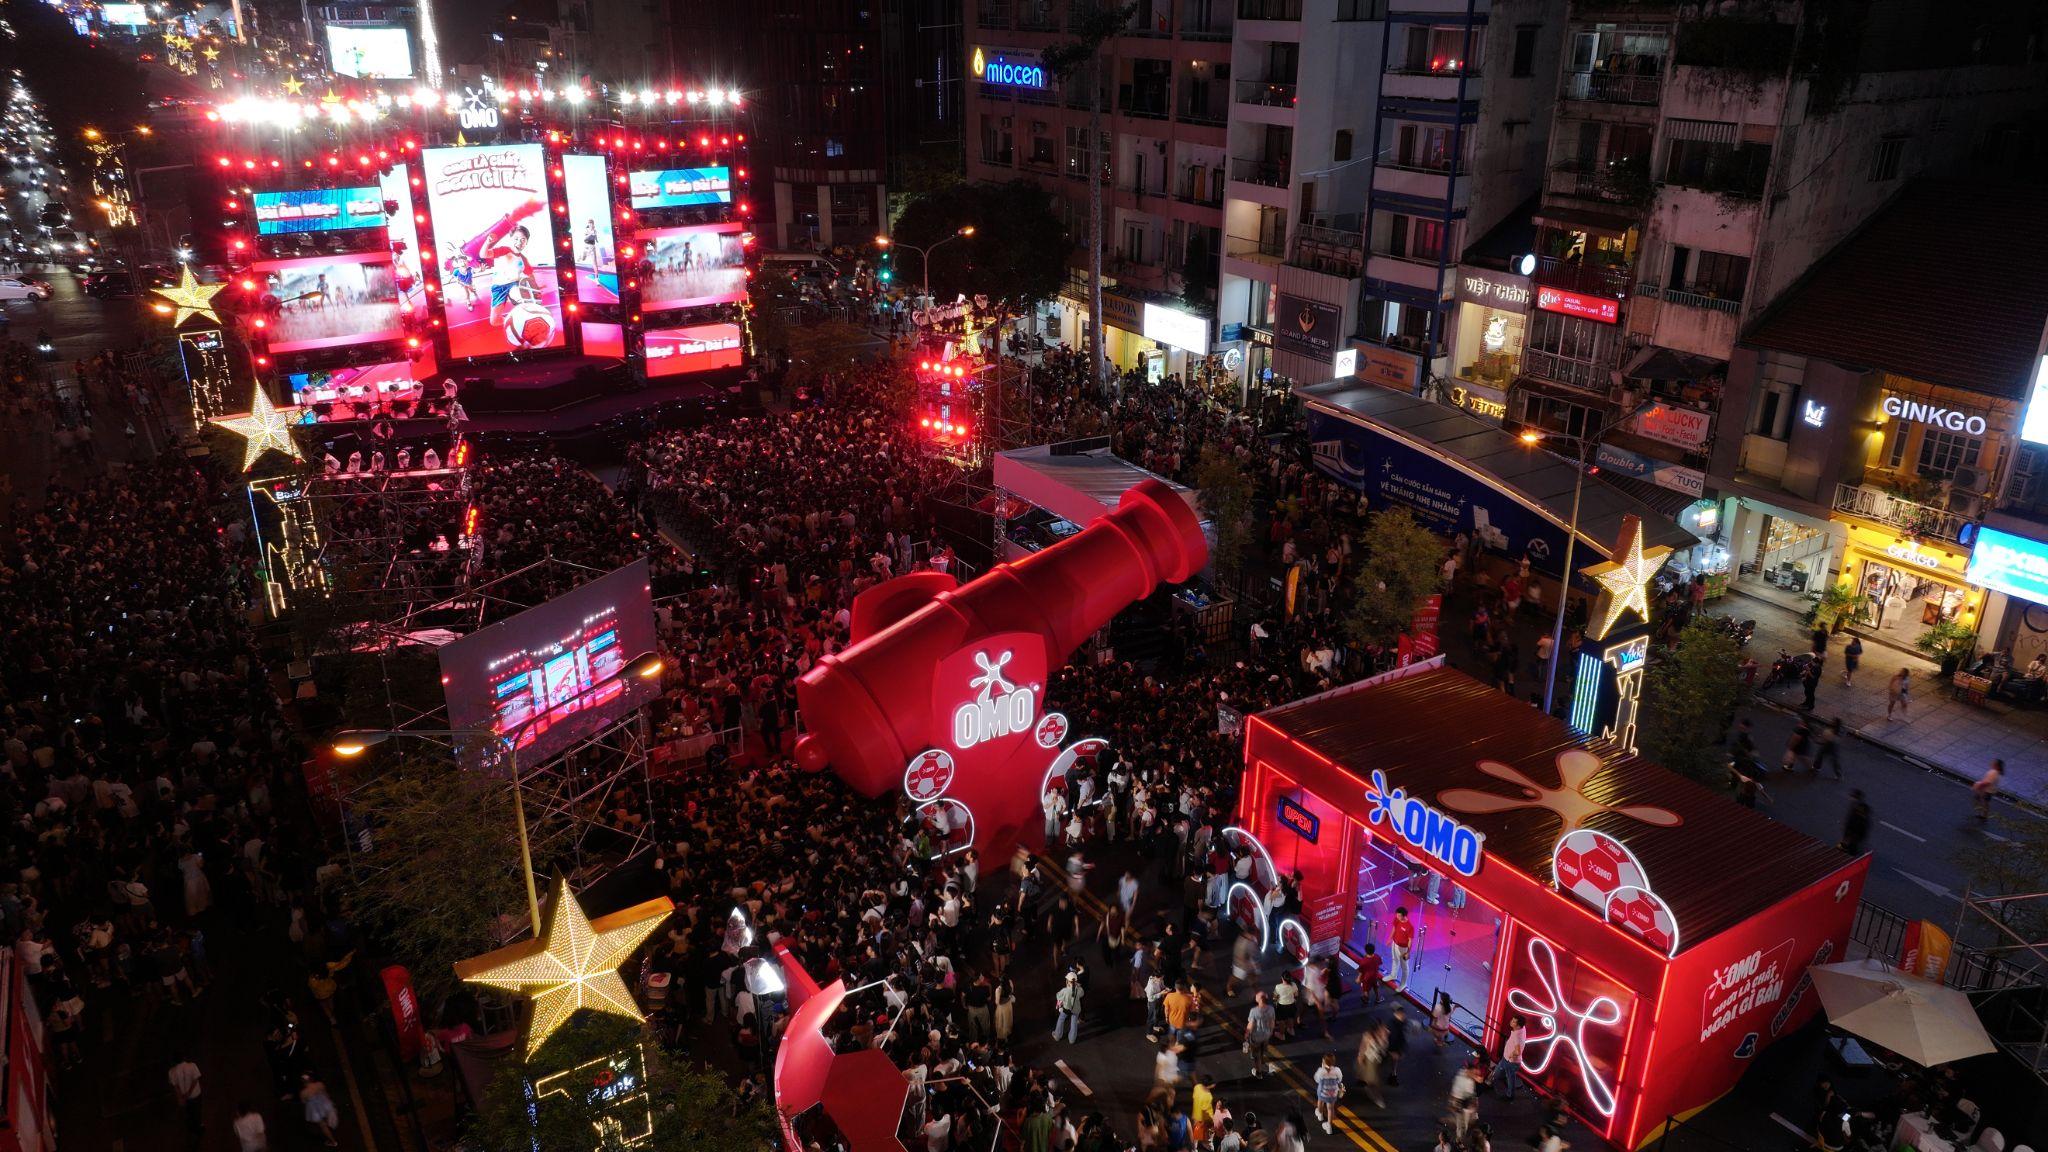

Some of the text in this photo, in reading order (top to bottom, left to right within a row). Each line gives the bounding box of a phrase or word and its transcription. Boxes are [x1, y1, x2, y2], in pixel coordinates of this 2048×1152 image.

[987, 57, 1042, 87] miocen
[460, 107, 498, 128] OMO
[1465, 277, 1491, 296] VIỆT
[1280, 328, 1302, 340] GRAND
[1302, 333, 1330, 348] PIONEERS
[1667, 412, 1704, 430] LUCKY
[1883, 396, 1987, 436] GINKGO
[1680, 429, 1698, 442] Facial
[1598, 451, 1645, 473] Double A
[955, 687, 1034, 749] OMO
[1284, 804, 1312, 835] OPEN
[1403, 798, 1478, 876] OMO
[1595, 865, 1613, 881] OMO
[1725, 950, 1762, 988] OMO
[1738, 980, 1751, 998] LÀ
[1700, 1011, 1738, 1043] NGẠI
[1738, 991, 1754, 1015] GÌ
